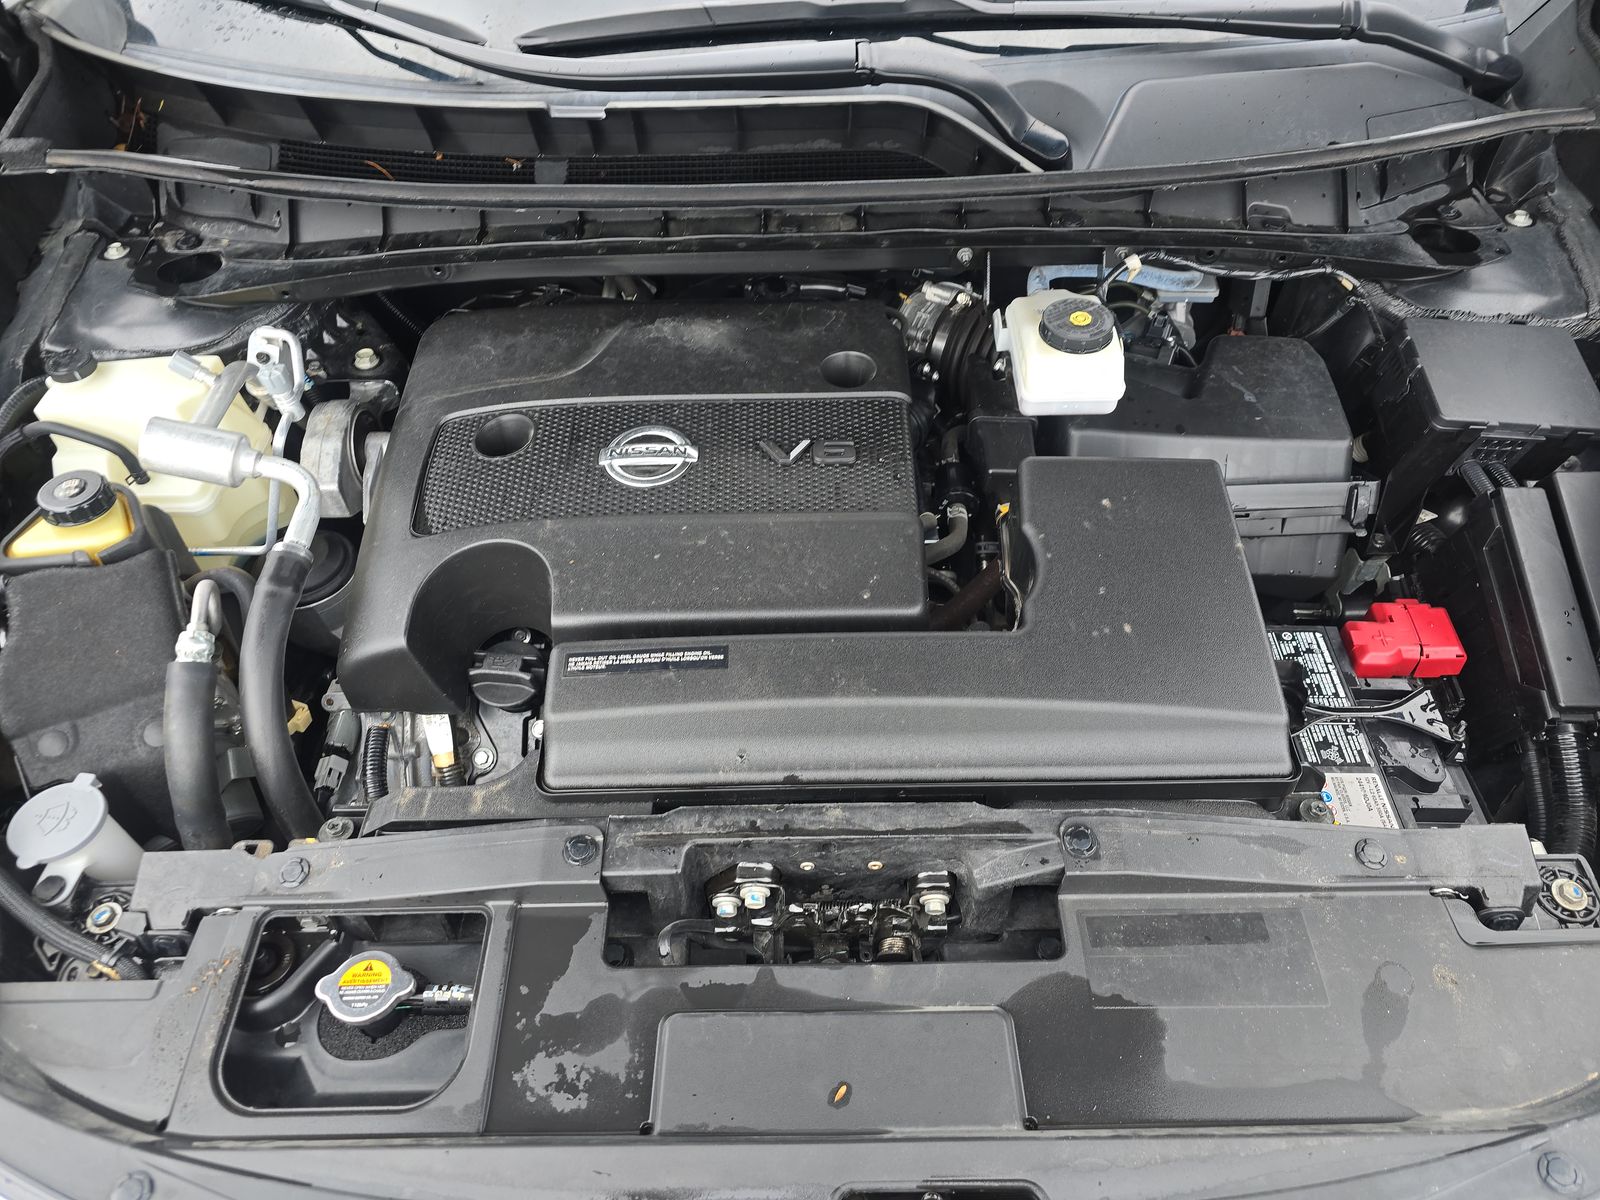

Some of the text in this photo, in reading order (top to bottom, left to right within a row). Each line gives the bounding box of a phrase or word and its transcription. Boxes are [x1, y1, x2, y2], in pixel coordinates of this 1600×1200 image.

[608, 446, 688, 458] NISSAN
[760, 440, 856, 466] V6
[1381, 802, 1394, 828] NISSAN
